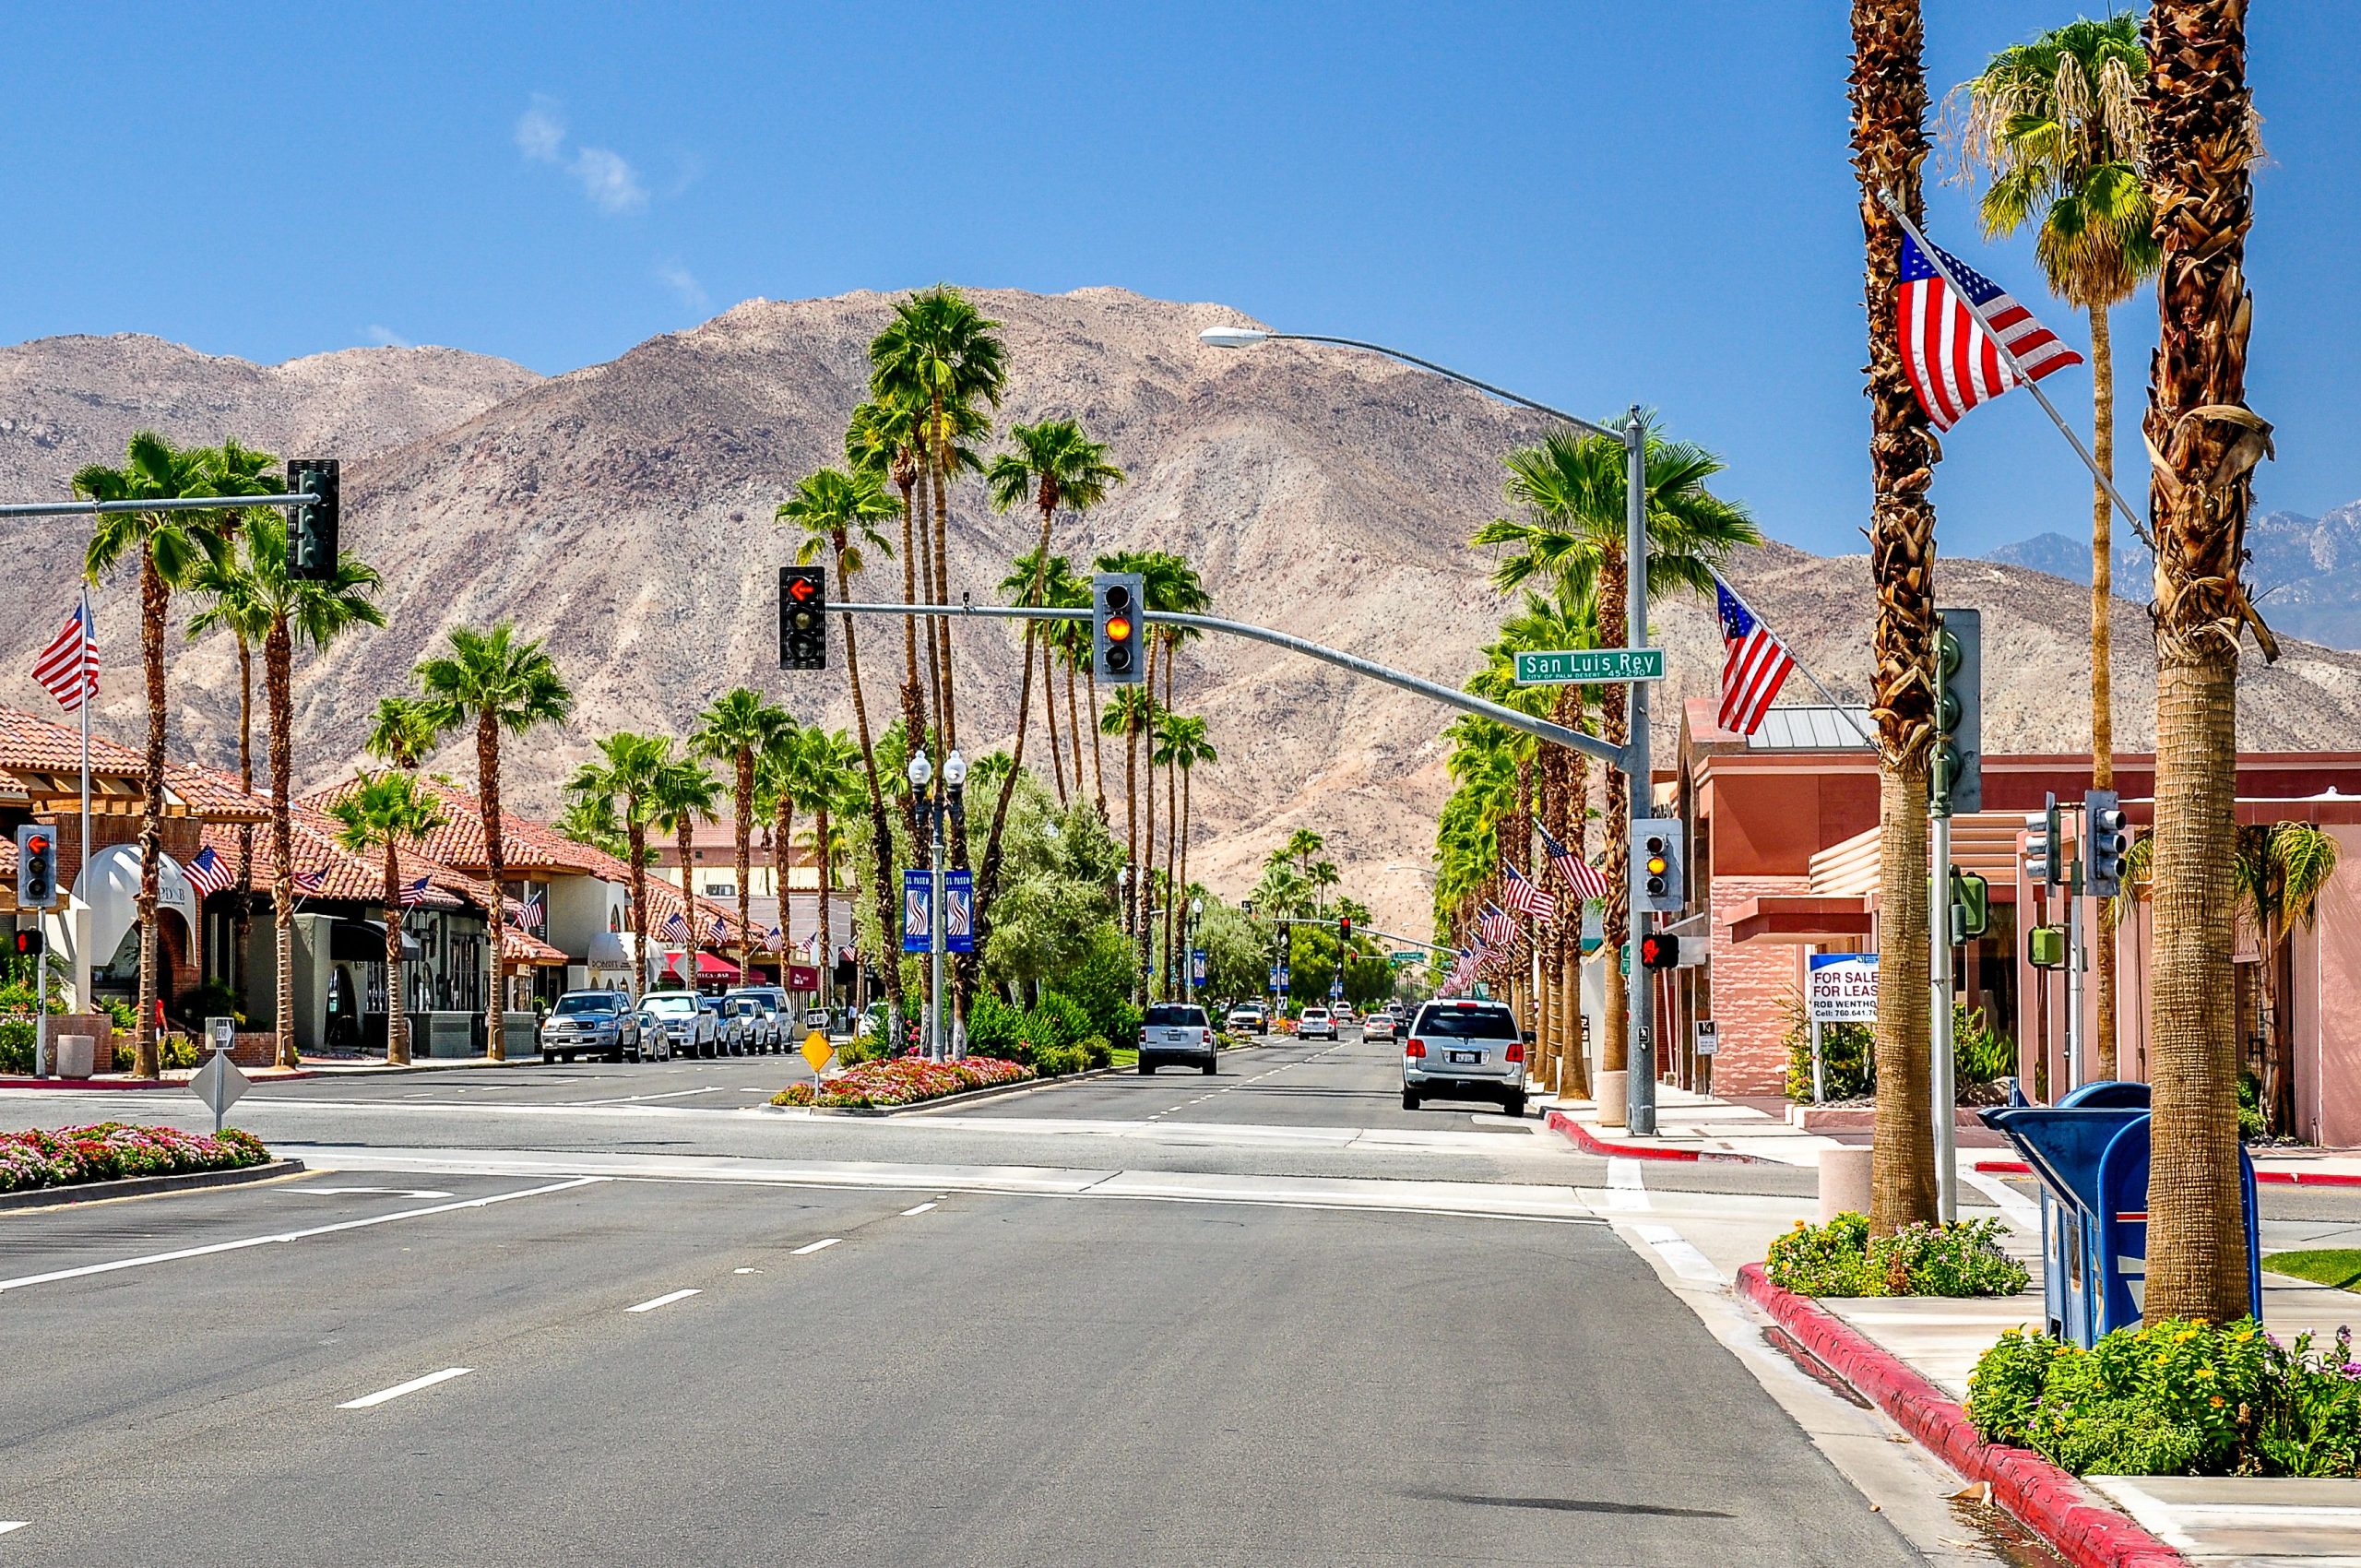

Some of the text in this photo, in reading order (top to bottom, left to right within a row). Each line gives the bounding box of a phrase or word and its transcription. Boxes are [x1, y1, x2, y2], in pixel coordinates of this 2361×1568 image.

[1526, 653, 1655, 673] San Luis Rey
[1608, 669, 1646, 678] 45-290
[906, 876, 930, 885] EL PASEO
[946, 877, 970, 885] EL PASEO
[1814, 972, 1880, 984] FOR SALE
[1813, 985, 1879, 997] FOR LEAS
[1835, 1000, 1878, 1008] WENTHO
